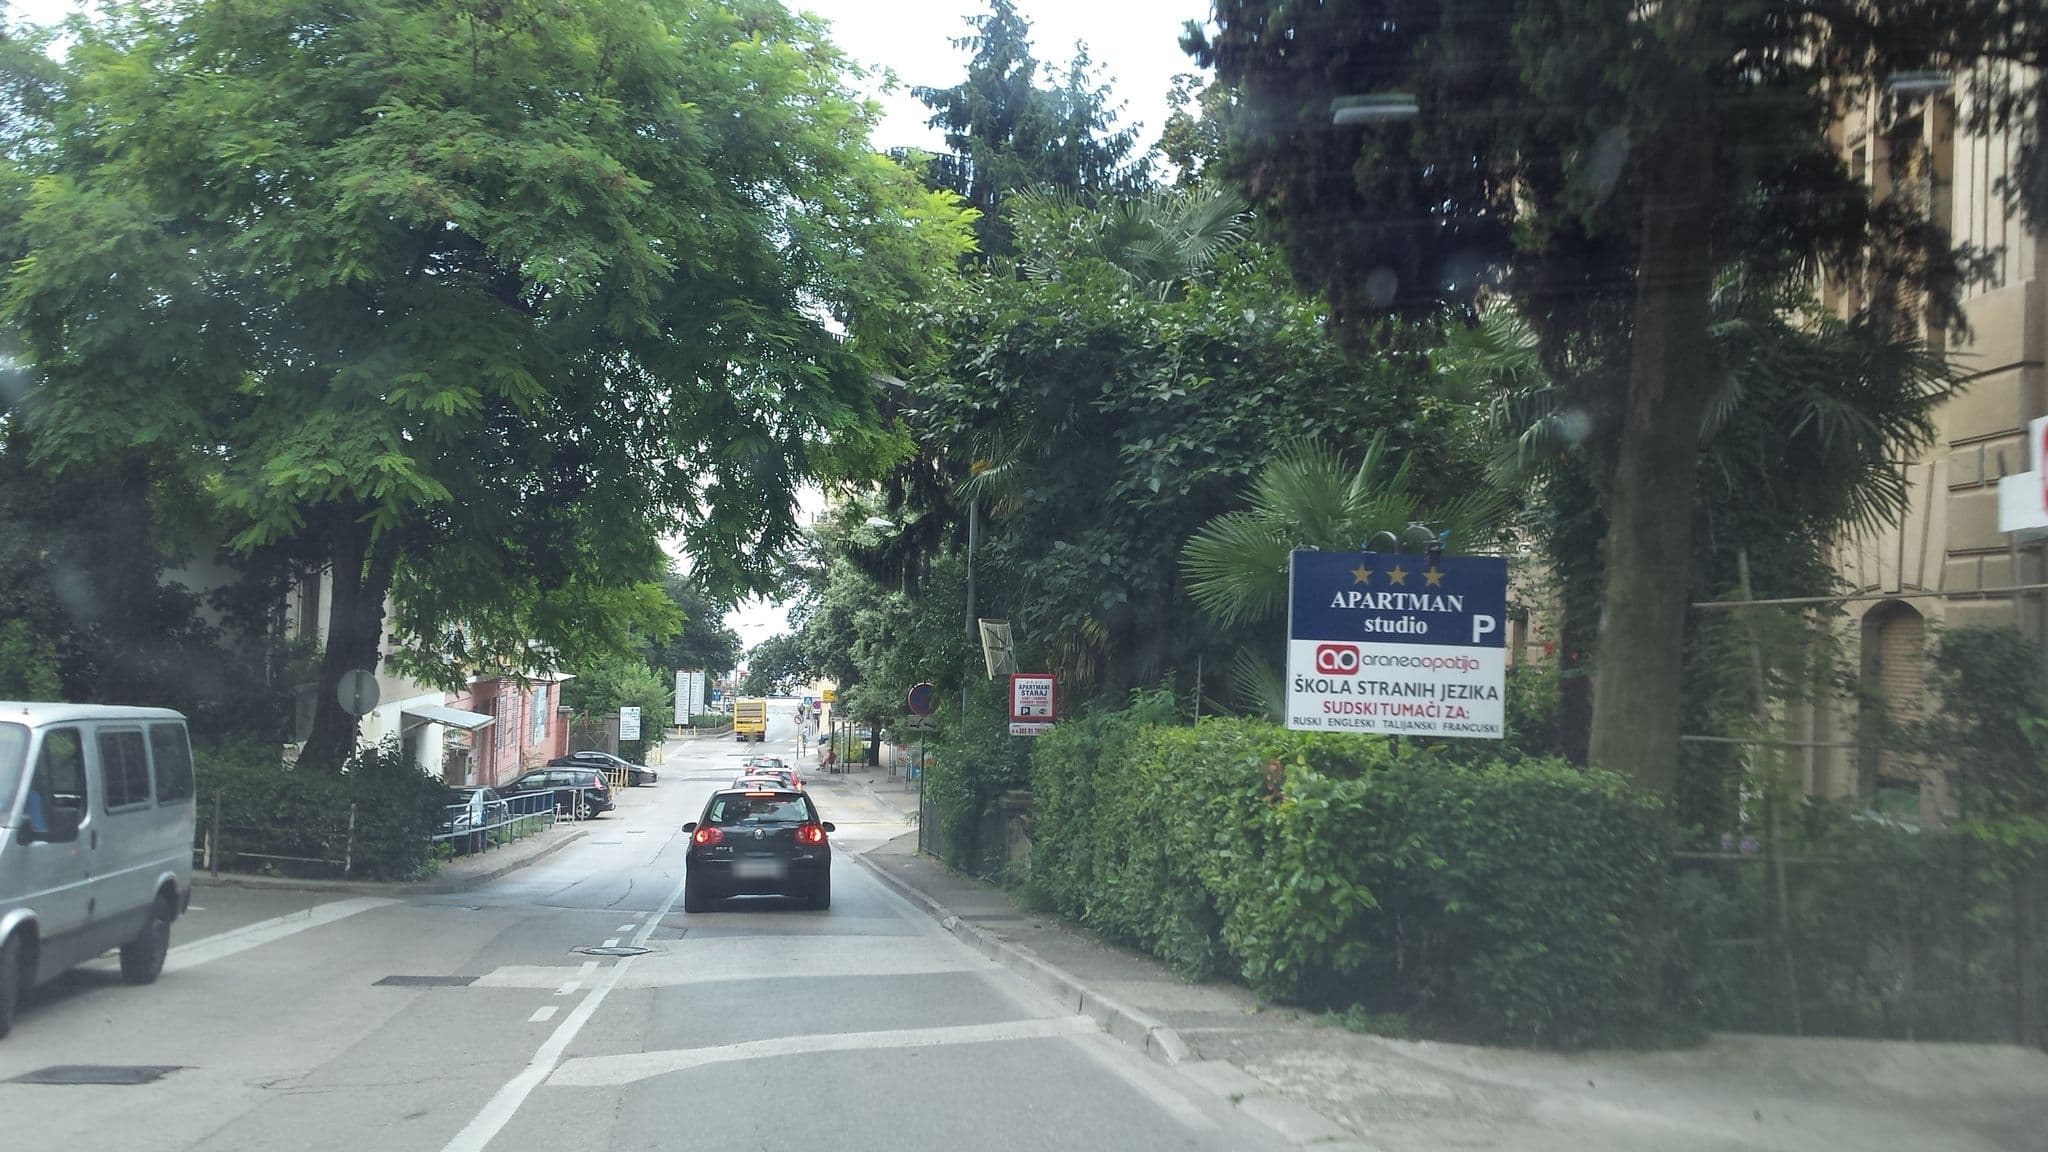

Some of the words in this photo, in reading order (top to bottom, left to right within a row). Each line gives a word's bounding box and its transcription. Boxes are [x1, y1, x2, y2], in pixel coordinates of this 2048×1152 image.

[1331, 591, 1464, 612] APARTMAN
[1364, 615, 1428, 634] studio
[1472, 614, 1497, 643] P
[1362, 654, 1480, 673] araneaopatija
[1294, 674, 1352, 695] ŠKOLA
[1357, 680, 1435, 699] STRANIH
[1440, 684, 1499, 702] JEZIKA
[1323, 700, 1377, 716] SUDSKI
[1380, 701, 1440, 718] TUMAČI
[1445, 706, 1470, 720] ZA:
[1293, 716, 1322, 727] RUSKI
[1327, 717, 1375, 729] ENGLESKI
[1382, 719, 1437, 731] TALIJANSKI
[1442, 721, 1499, 734] FRANCUSKI
